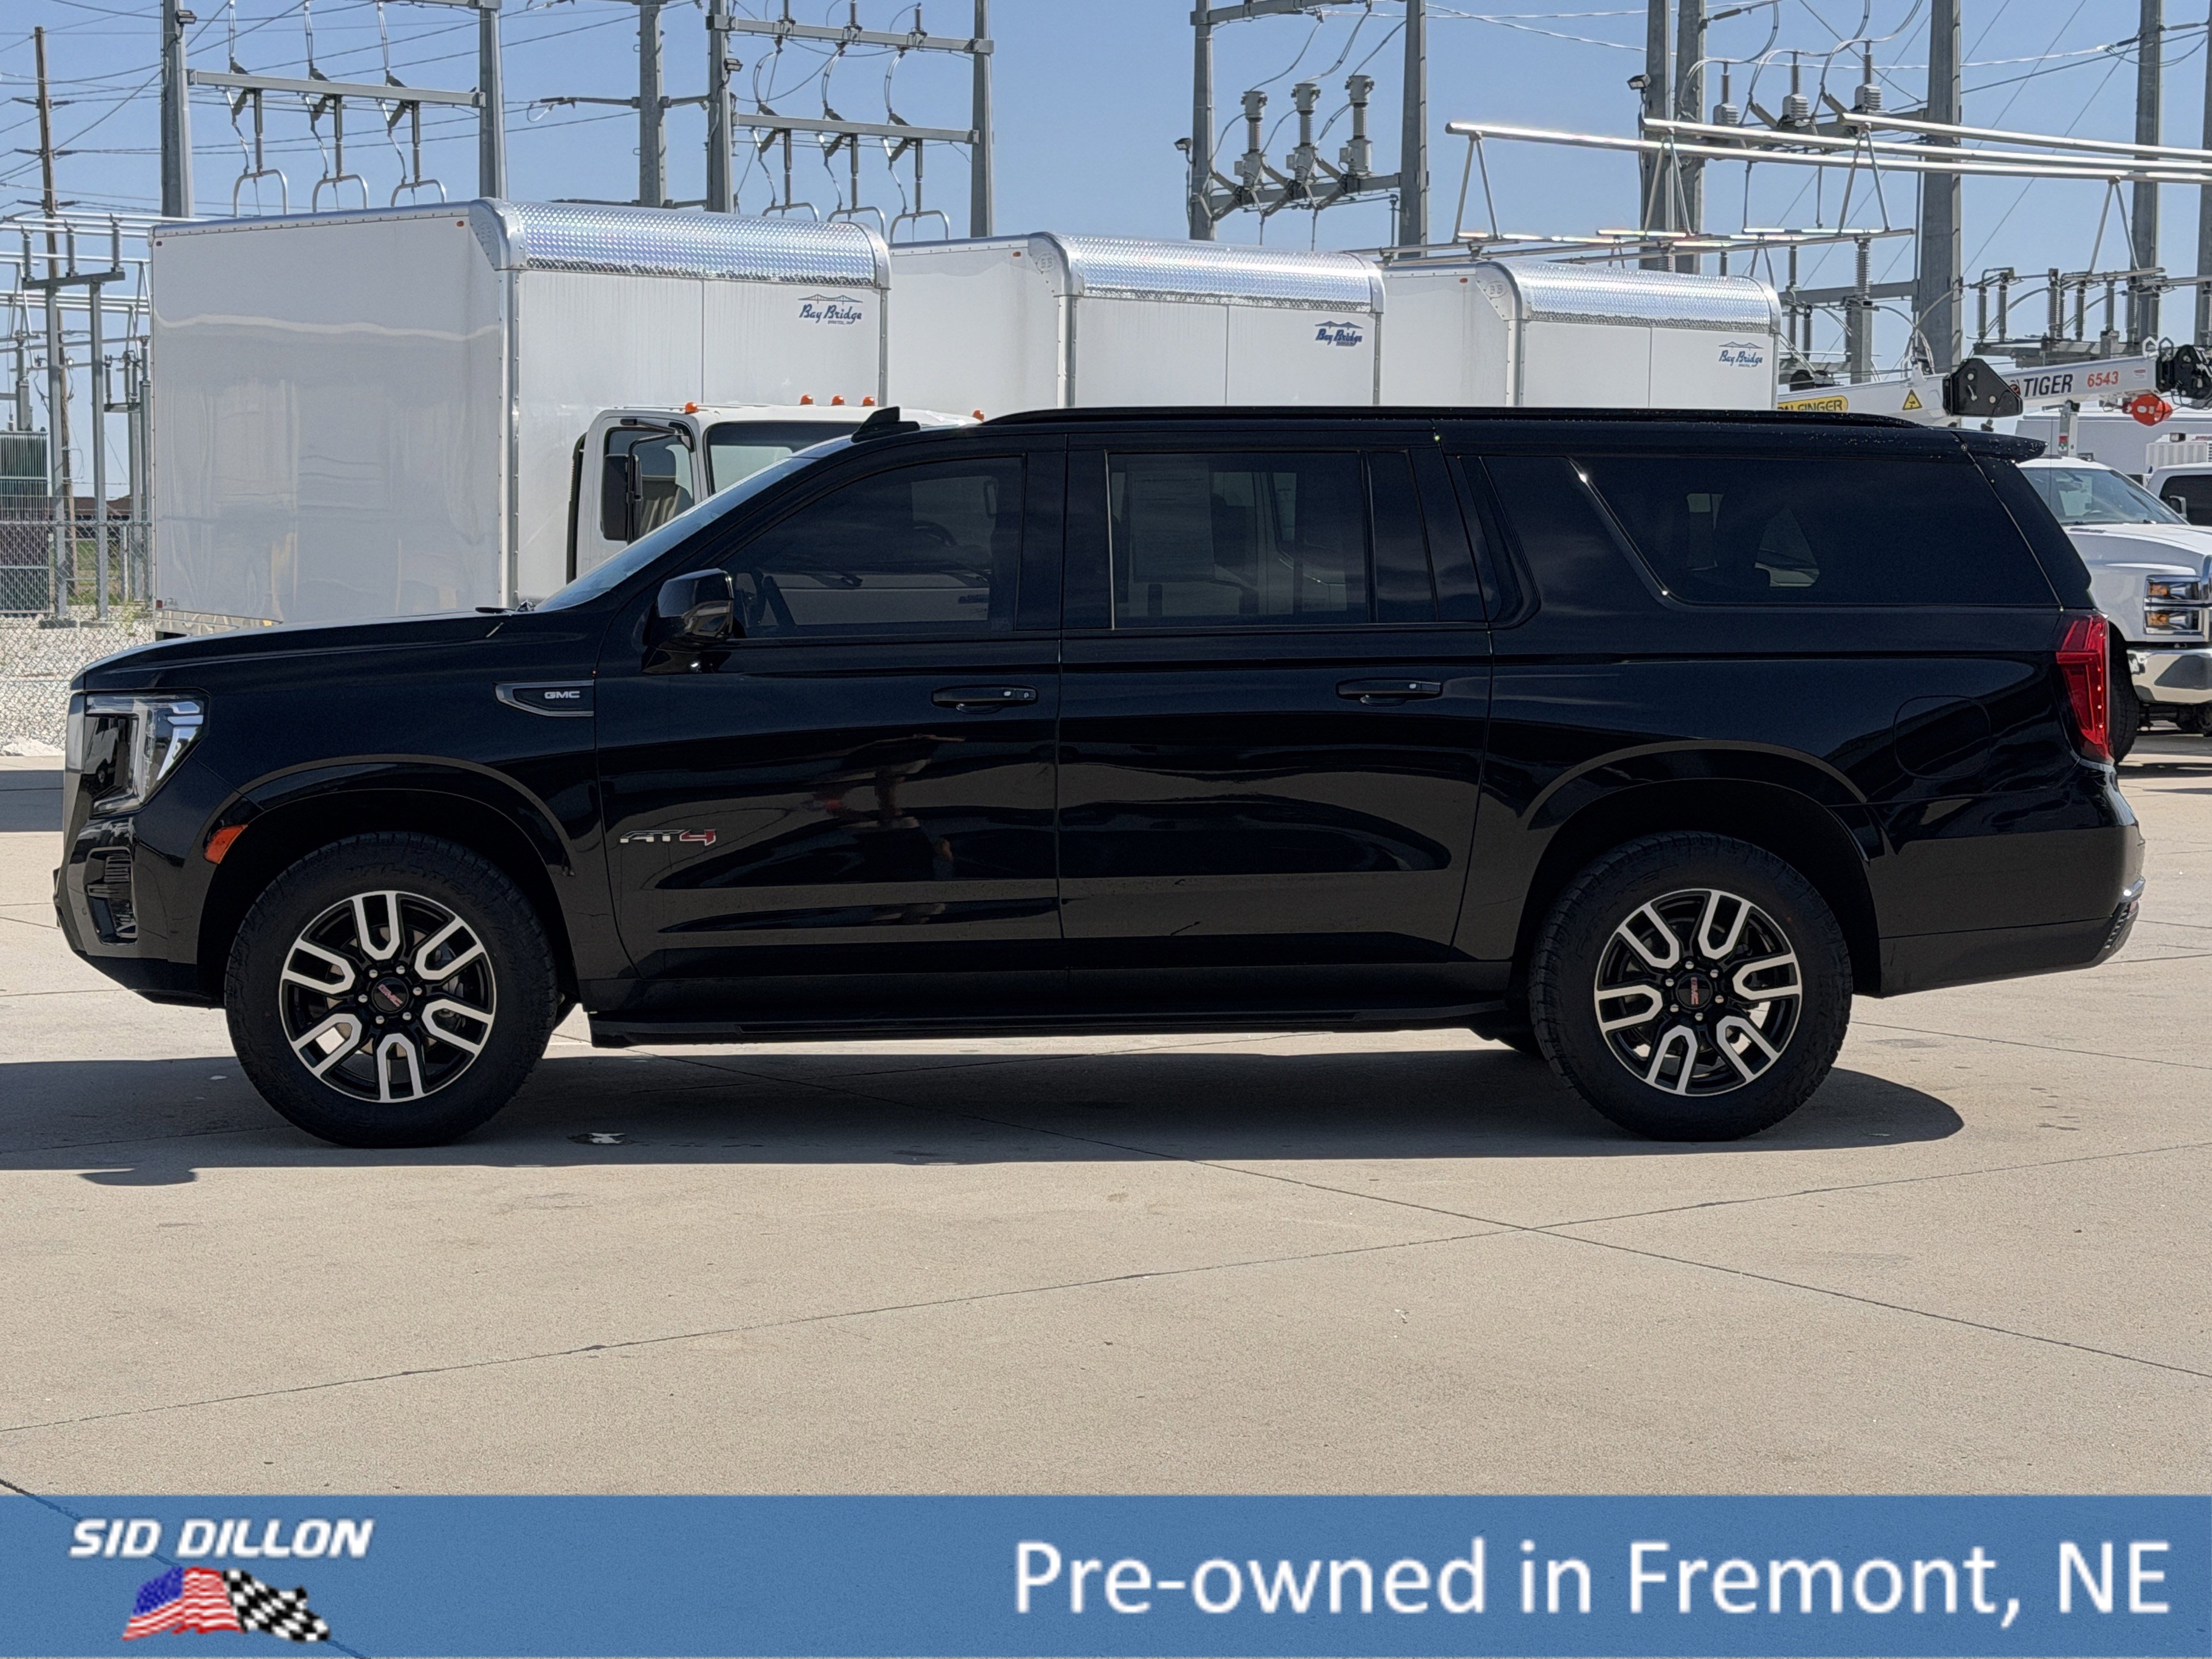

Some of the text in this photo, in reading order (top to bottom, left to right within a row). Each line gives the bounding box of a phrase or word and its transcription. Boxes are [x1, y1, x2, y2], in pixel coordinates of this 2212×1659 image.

[799, 303, 862, 324] Bay Bridge
[1315, 328, 1334, 346] Bay
[1719, 349, 1735, 366] Bay
[2023, 374, 2073, 397] TIGER
[2087, 371, 2119, 388] 6543
[544, 691, 580, 699] GMC
[619, 829, 716, 846] AT4
